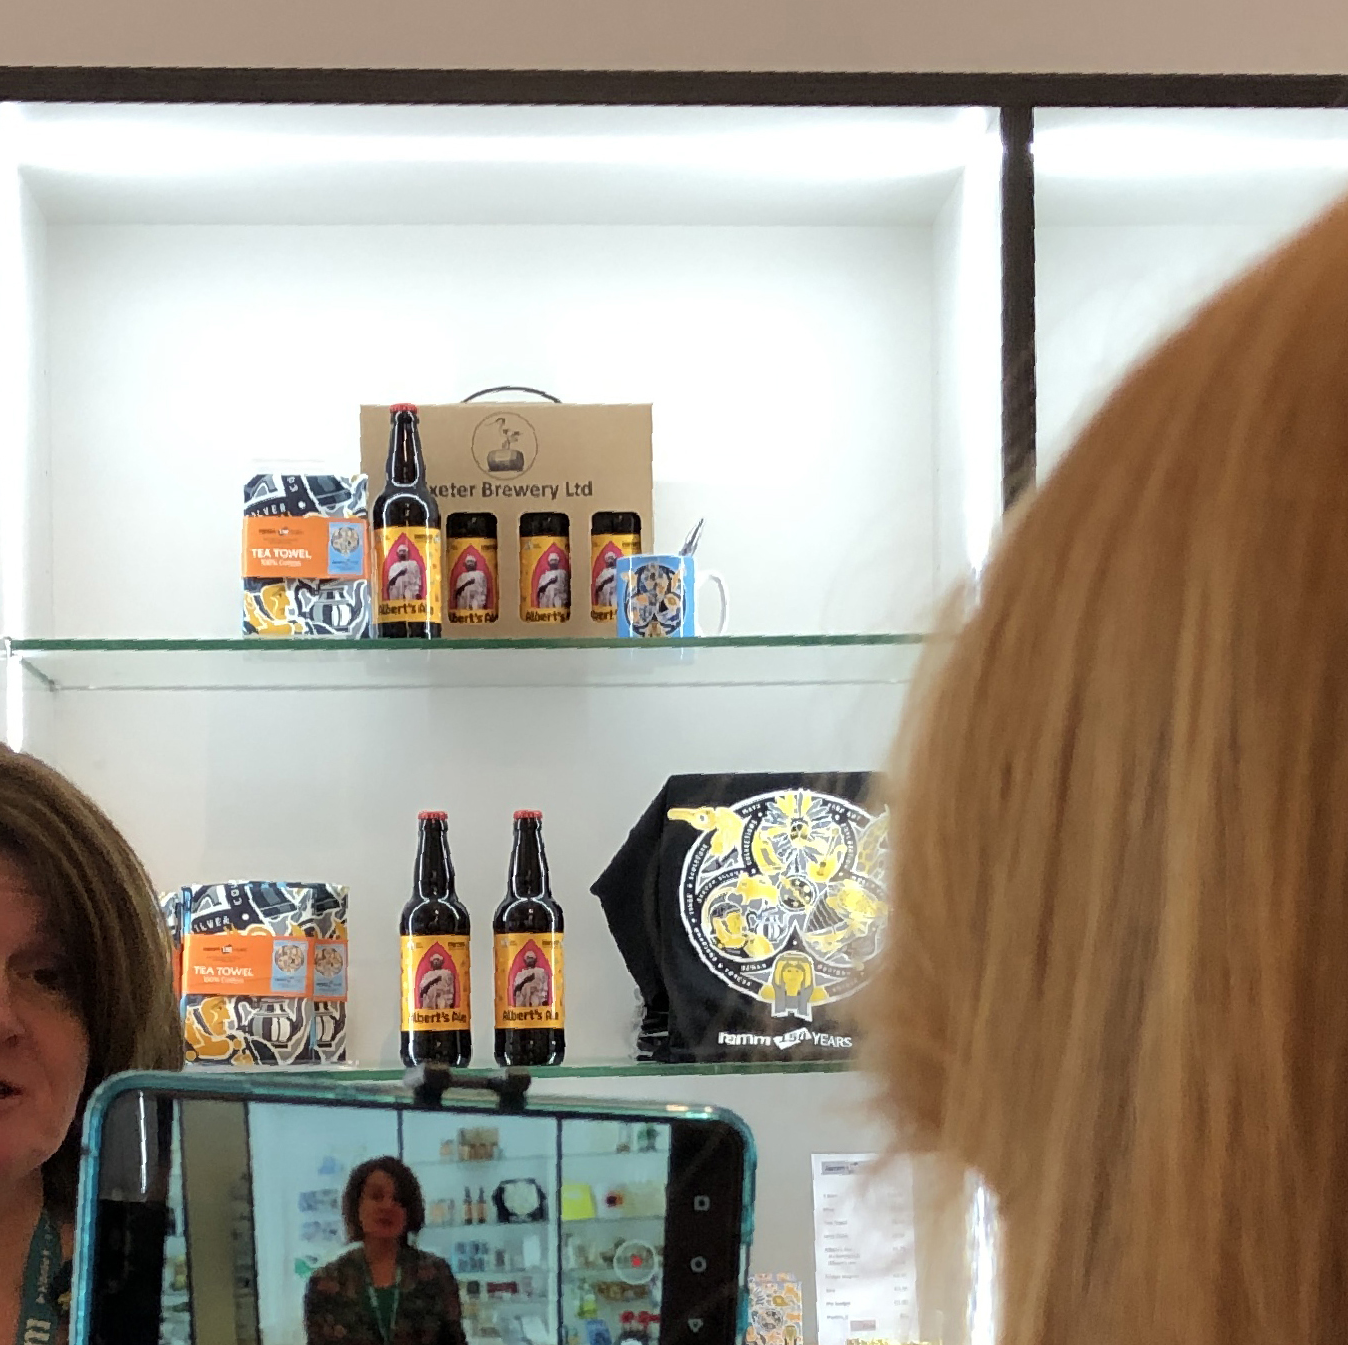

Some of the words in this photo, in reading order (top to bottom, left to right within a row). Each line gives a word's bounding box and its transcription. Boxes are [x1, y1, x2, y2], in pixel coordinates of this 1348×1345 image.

[430, 483, 475, 498] xeter
[482, 482, 559, 500] Brewery
[566, 481, 593, 497] Ltd
[252, 549, 271, 558] TEA
[273, 549, 311, 559] TOWEL
[193, 916, 230, 932] ILVER
[194, 965, 214, 976] TEA
[216, 967, 253, 976] TOWEL
[503, 1010, 542, 1021] Albert's
[718, 1031, 771, 1046] ramm
[811, 1031, 853, 1048] YEARS
